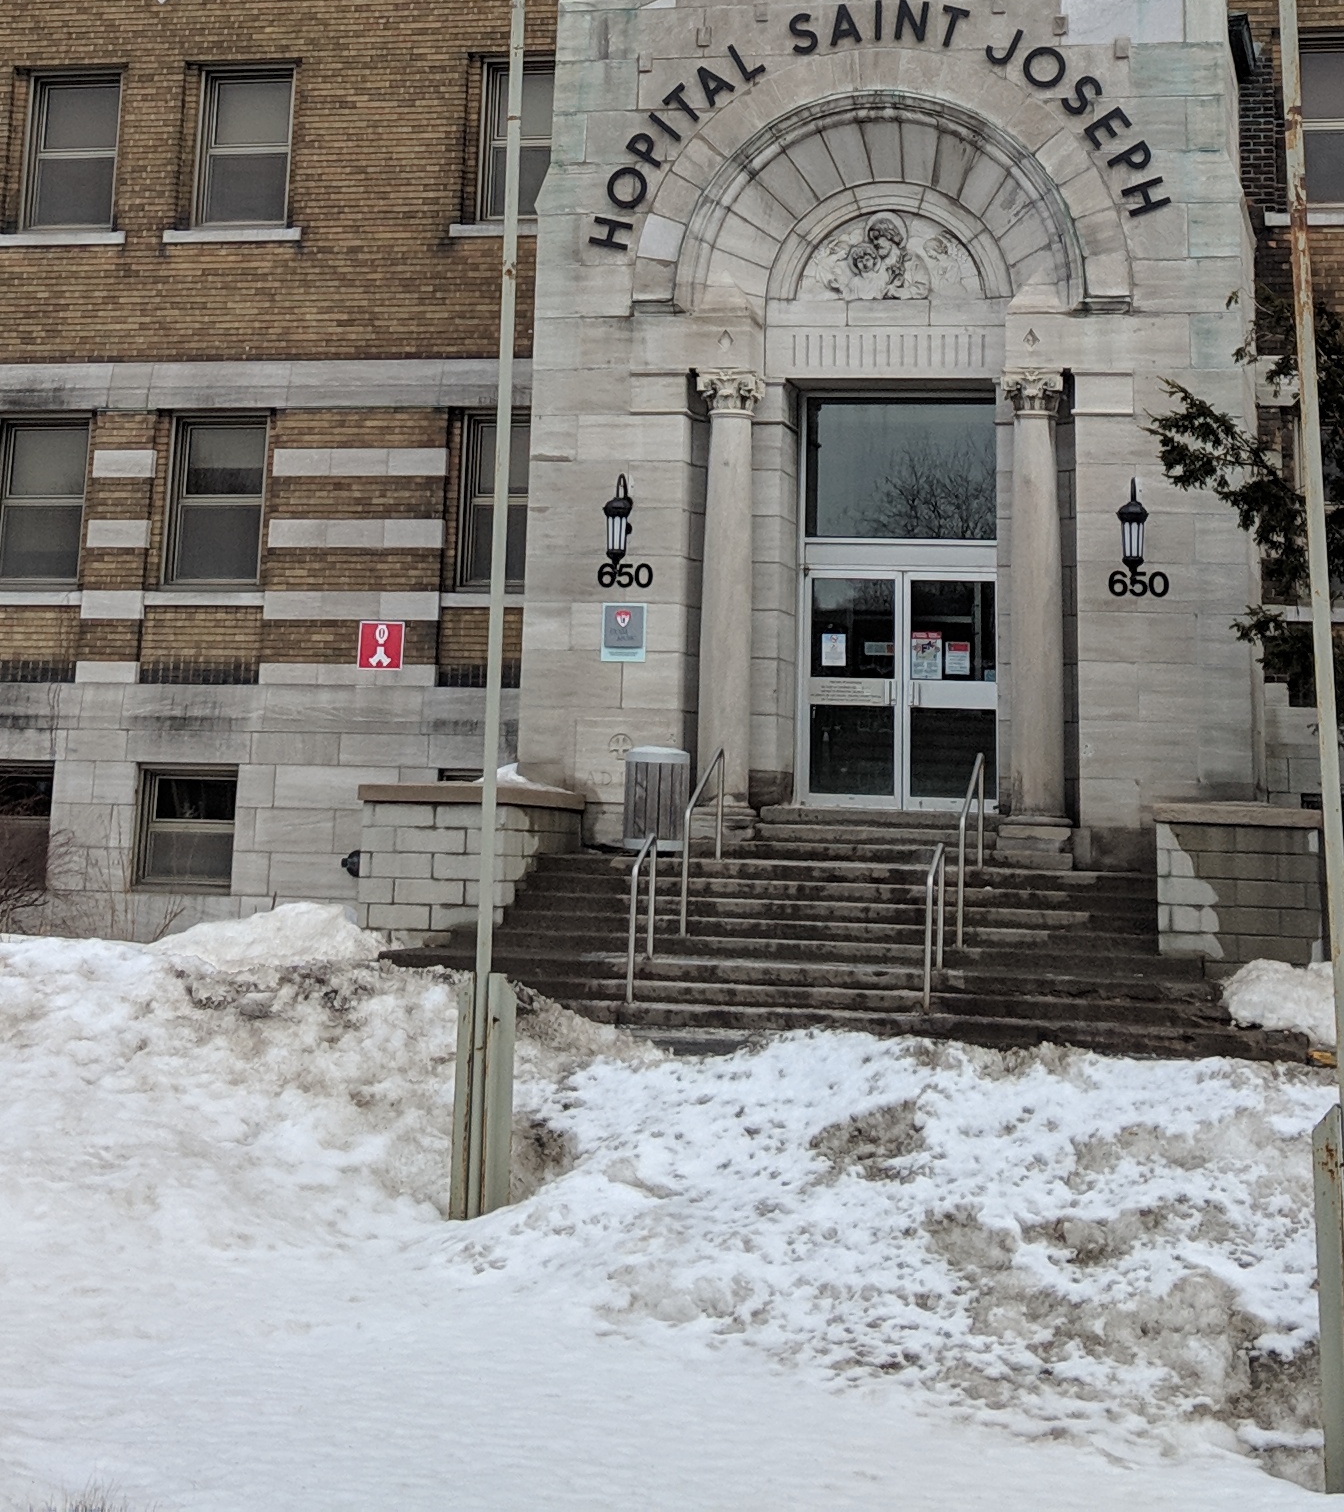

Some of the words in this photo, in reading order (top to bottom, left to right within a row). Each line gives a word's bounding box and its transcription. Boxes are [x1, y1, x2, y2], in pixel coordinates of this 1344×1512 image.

[588, 43, 766, 251] HOPITAL
[985, 29, 1172, 217] JOSEPH
[597, 563, 653, 588] 650
[1108, 570, 1169, 598] 650
